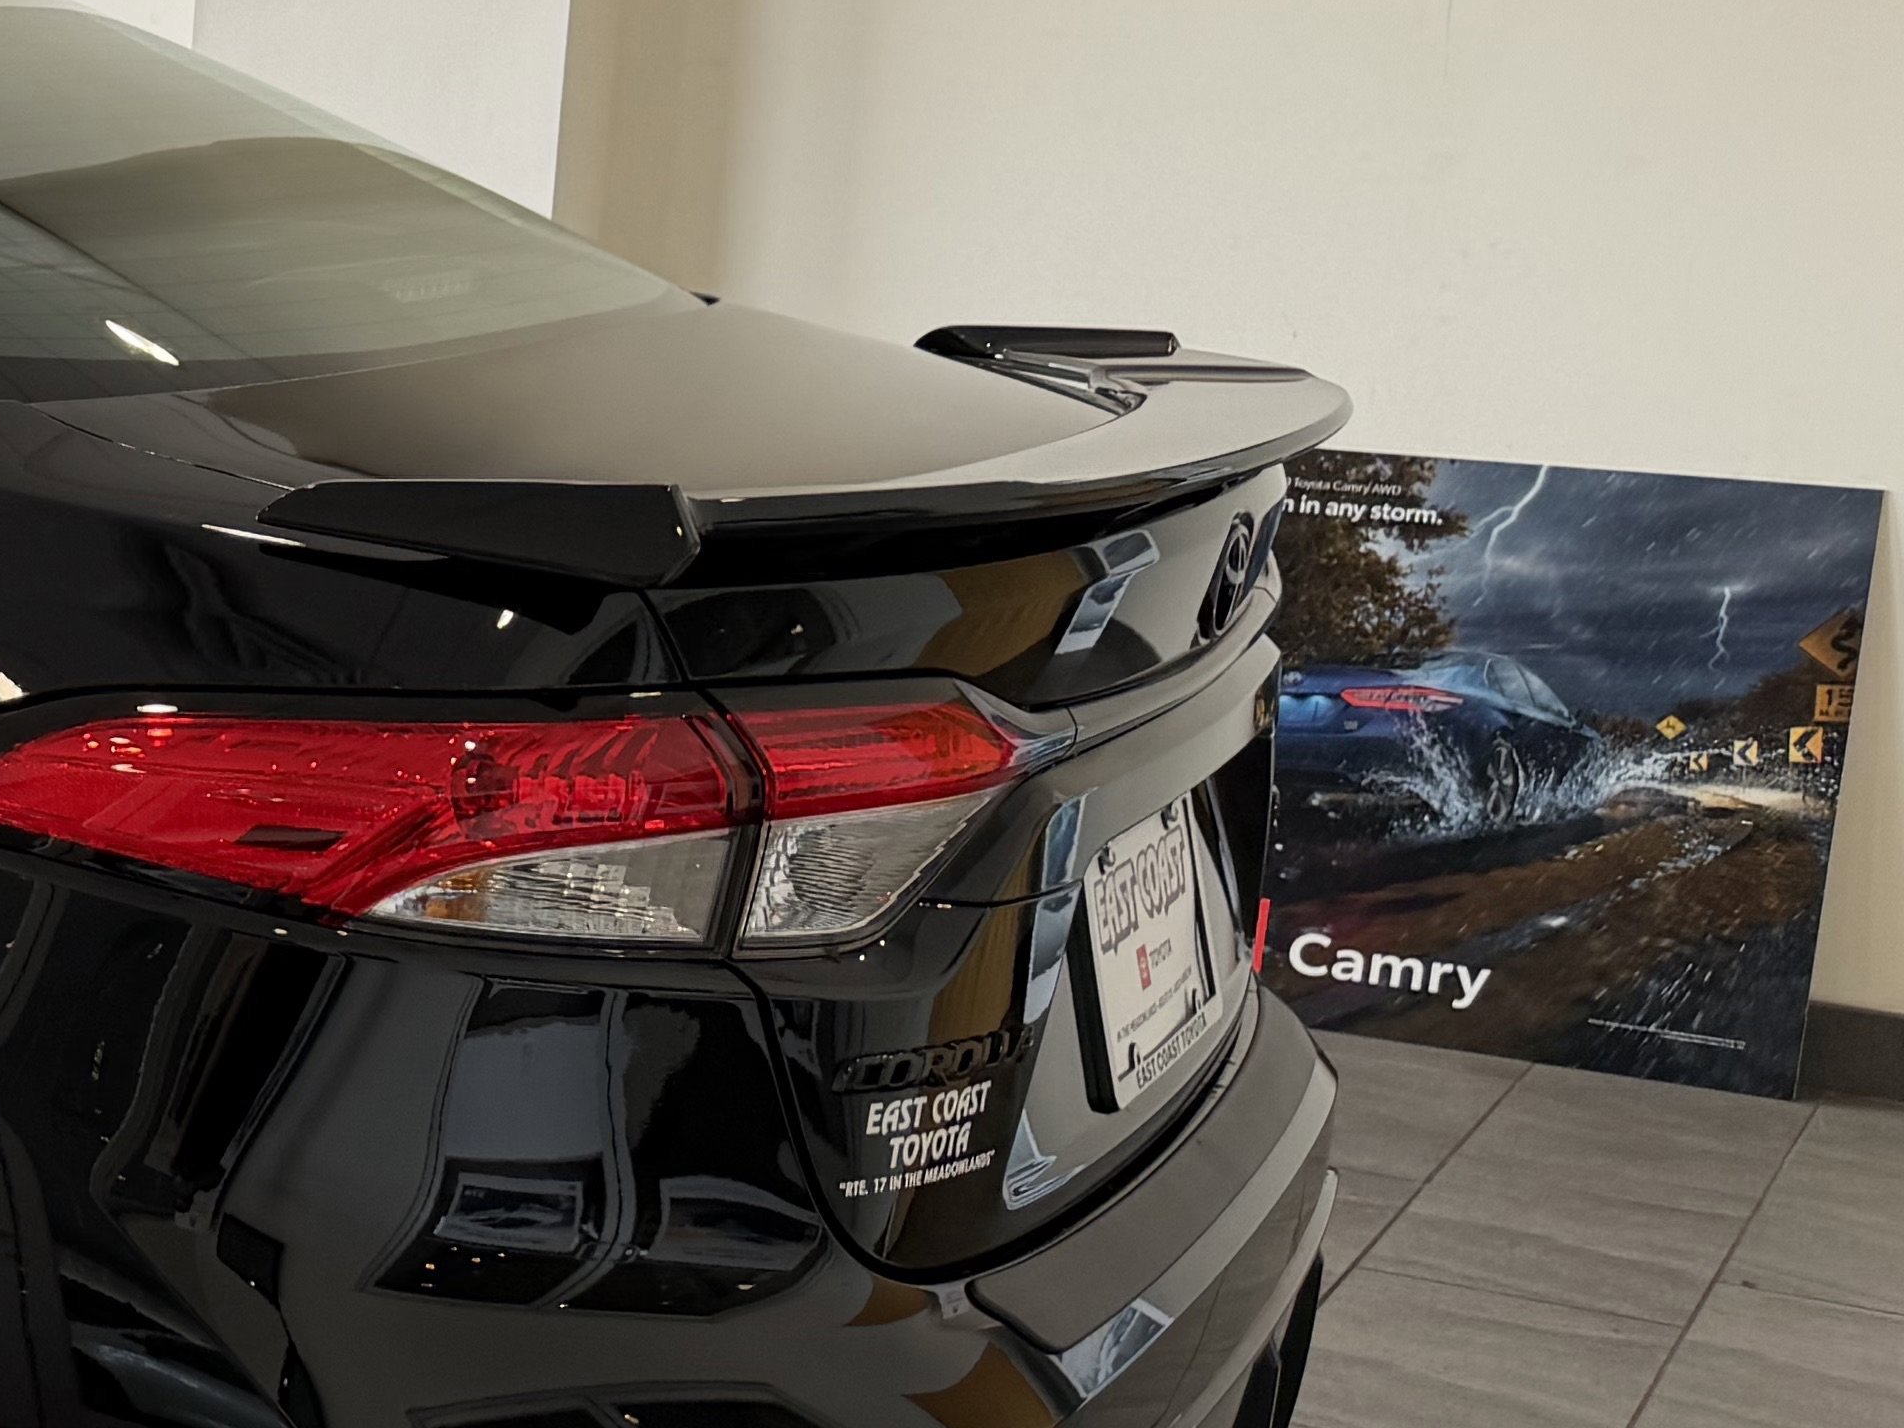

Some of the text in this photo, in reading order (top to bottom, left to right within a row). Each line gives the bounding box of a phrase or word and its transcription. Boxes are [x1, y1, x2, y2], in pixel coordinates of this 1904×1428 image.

[1294, 476, 1331, 491] Toyota
[1371, 483, 1402, 496] AWD
[1299, 494, 1321, 515] in
[1325, 500, 1368, 523] any
[1370, 502, 1444, 526] storm.
[1093, 823, 1187, 956] EAST COAST
[1288, 932, 1492, 1010] Camry
[1136, 1010, 1208, 1090] EAST COAST TOYOTA
[865, 1079, 993, 1136] EAST COAST
[888, 1121, 973, 1170] TOYOTA
[873, 1175, 888, 1194] 17
[888, 1173, 902, 1192] IN
[903, 1168, 923, 1189] THE
